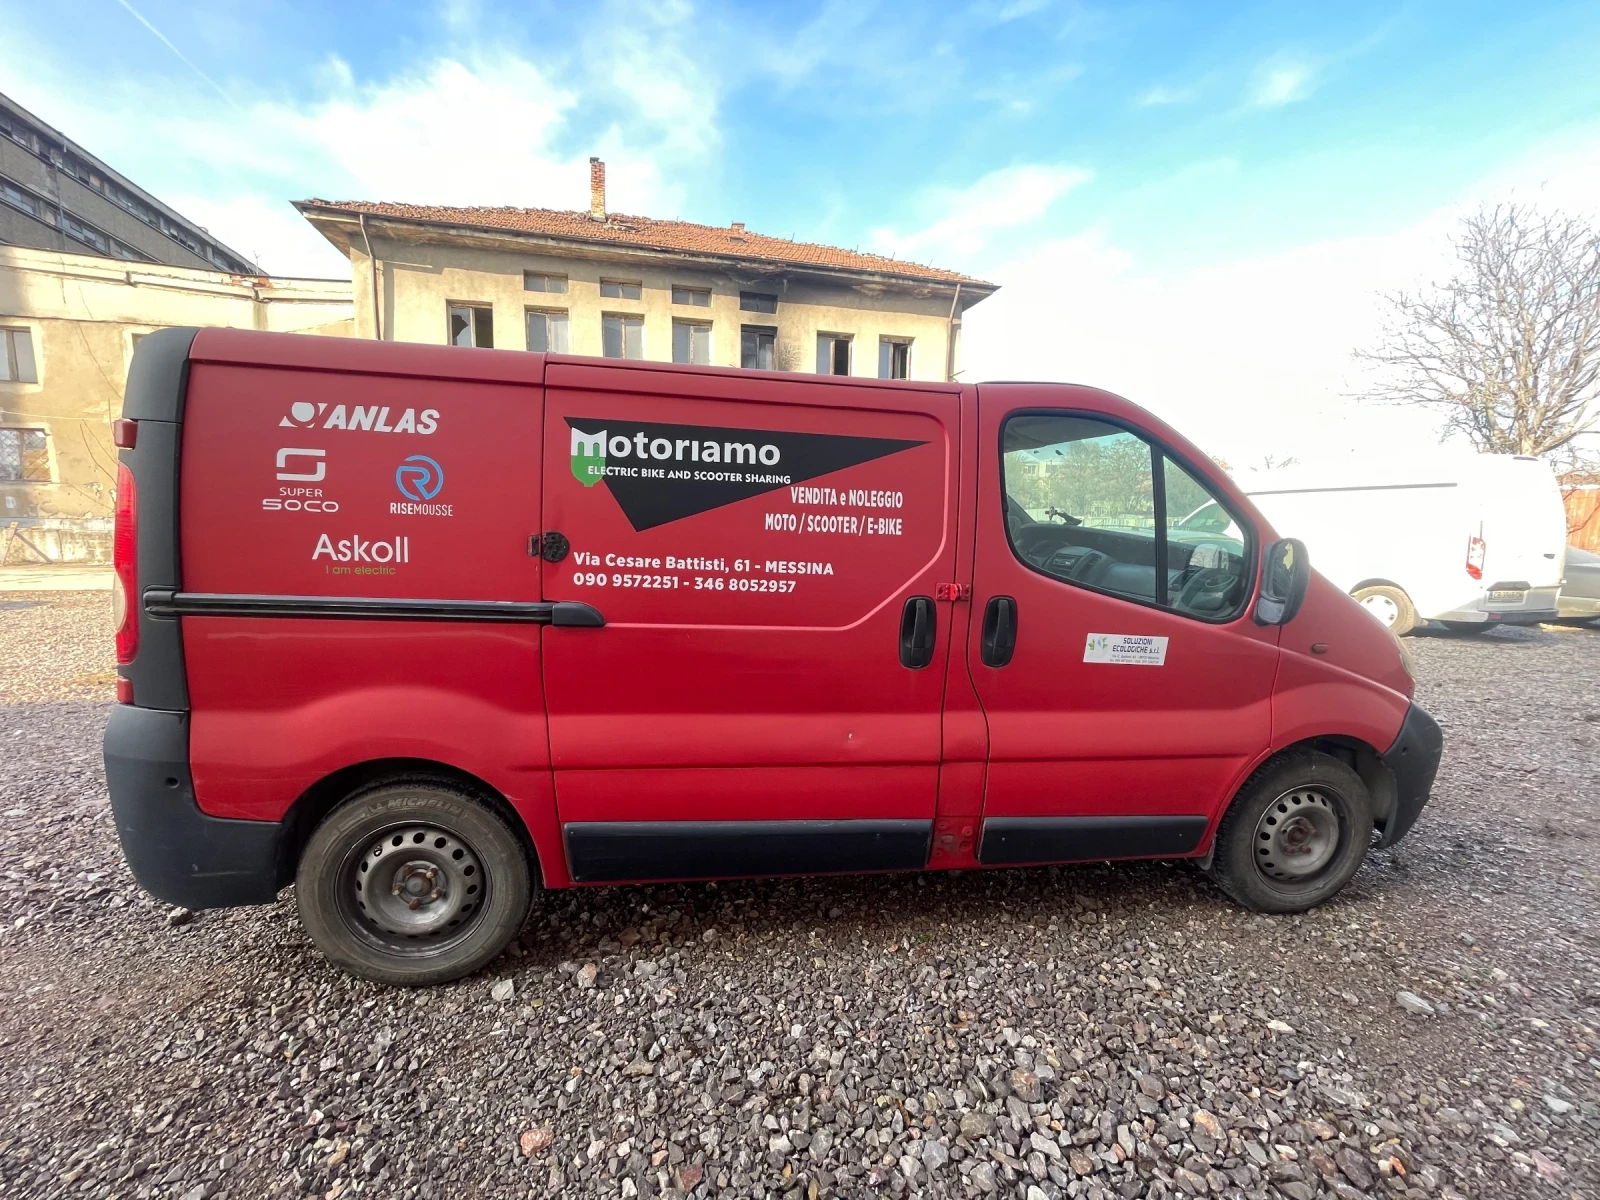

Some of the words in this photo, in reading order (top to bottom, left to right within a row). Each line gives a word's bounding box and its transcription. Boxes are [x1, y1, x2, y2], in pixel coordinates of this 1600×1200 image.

[323, 404, 440, 434] ANLAS
[588, 465, 638, 477] ELECTRIC
[641, 468, 665, 478] BIKE
[667, 469, 691, 479] AND
[694, 470, 743, 482] SCOOTER
[745, 473, 791, 485] SHARING
[279, 487, 323, 497] SUPER
[790, 486, 838, 506] VENDITA
[840, 492, 847, 506] e
[848, 489, 903, 509] NOLEGGIO
[262, 498, 339, 513] SOCO
[389, 502, 454, 517] RISEMOUSSE
[765, 513, 797, 532] MOTO
[807, 514, 858, 534] SCOOTER
[867, 517, 903, 536] E-BIKE
[311, 533, 409, 563] Askoll
[332, 566, 351, 575] am
[354, 565, 396, 575] electric
[573, 551, 601, 566] Via
[605, 553, 661, 569] Cesare
[665, 556, 730, 573] Battisti,
[734, 559, 751, 572] 61
[765, 560, 834, 575] MESSINA
[573, 572, 608, 587] 090
[612, 573, 679, 589] 9572251
[694, 577, 725, 591] 346
[728, 578, 797, 593] 8052957
[1112, 645, 1148, 653] ECOLOGICHE
[1123, 637, 1153, 645] SOLUZIONI
